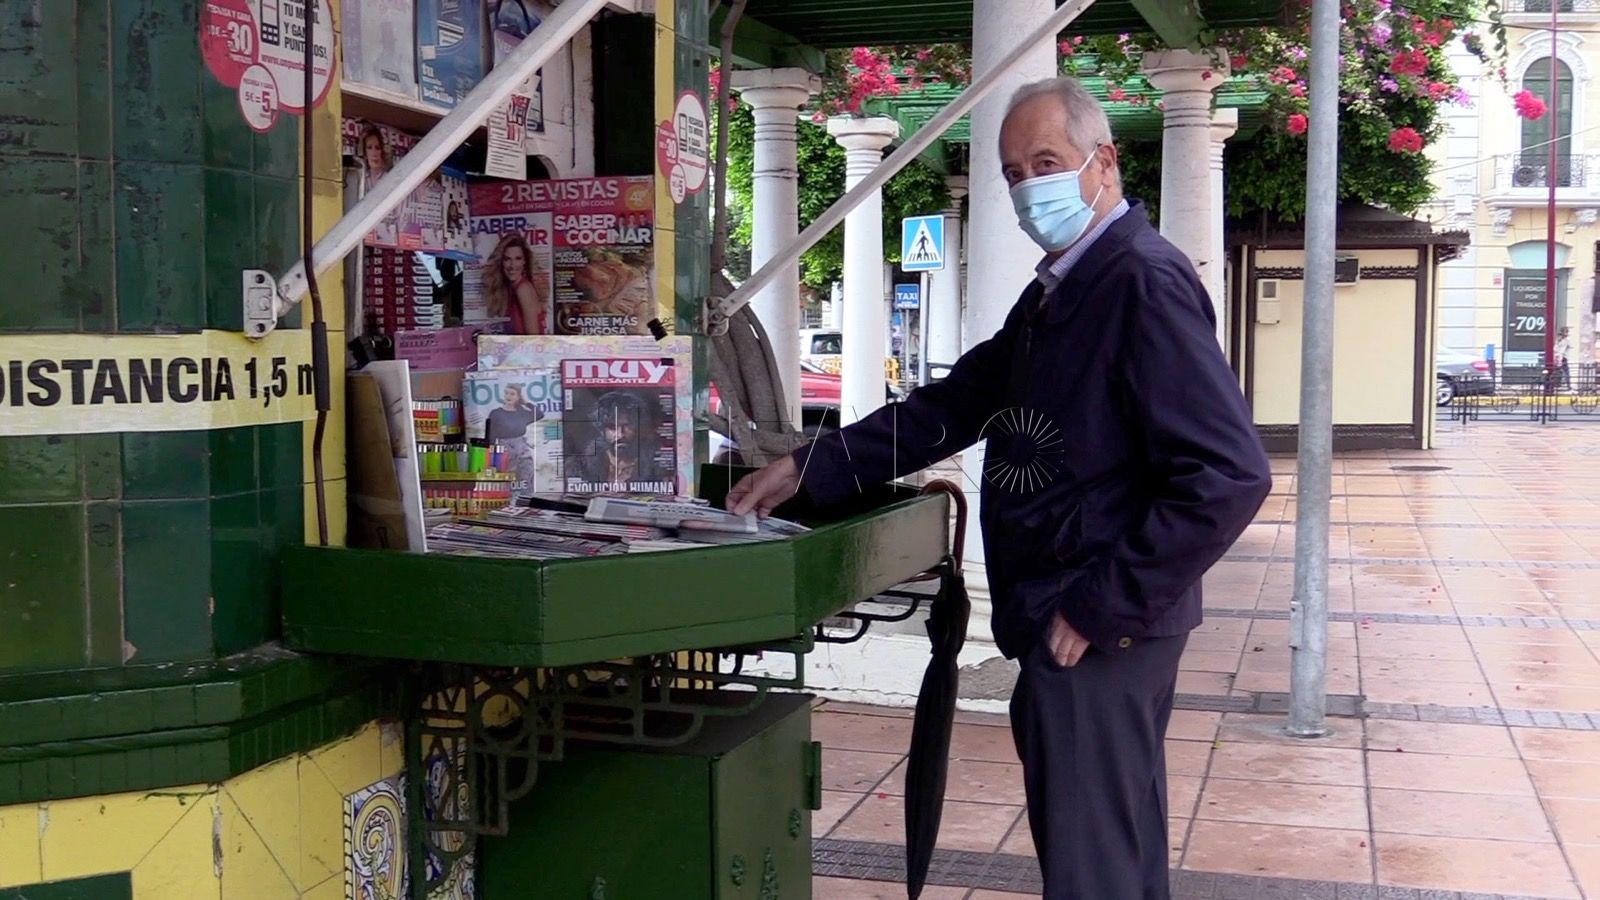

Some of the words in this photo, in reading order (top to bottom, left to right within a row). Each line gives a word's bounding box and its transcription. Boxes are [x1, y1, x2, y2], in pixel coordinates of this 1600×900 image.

[283, 3, 293, 16] TU
[284, 22, 289, 34] Y
[501, 185, 514, 203] 2
[517, 180, 620, 202] REVISTAS
[554, 214, 616, 230] SABER
[566, 228, 651, 245] COCINAR
[897, 292, 917, 300] TAXI
[568, 317, 610, 327] CARNE
[612, 314, 638, 326] MÁS
[1509, 316, 1547, 331] -70%
[579, 327, 627, 335] JUGOSA
[565, 360, 669, 384] muy
[244, 357, 288, 408] 1,5
[537, 399, 563, 413] plu
[629, 481, 674, 494] HUMANA
